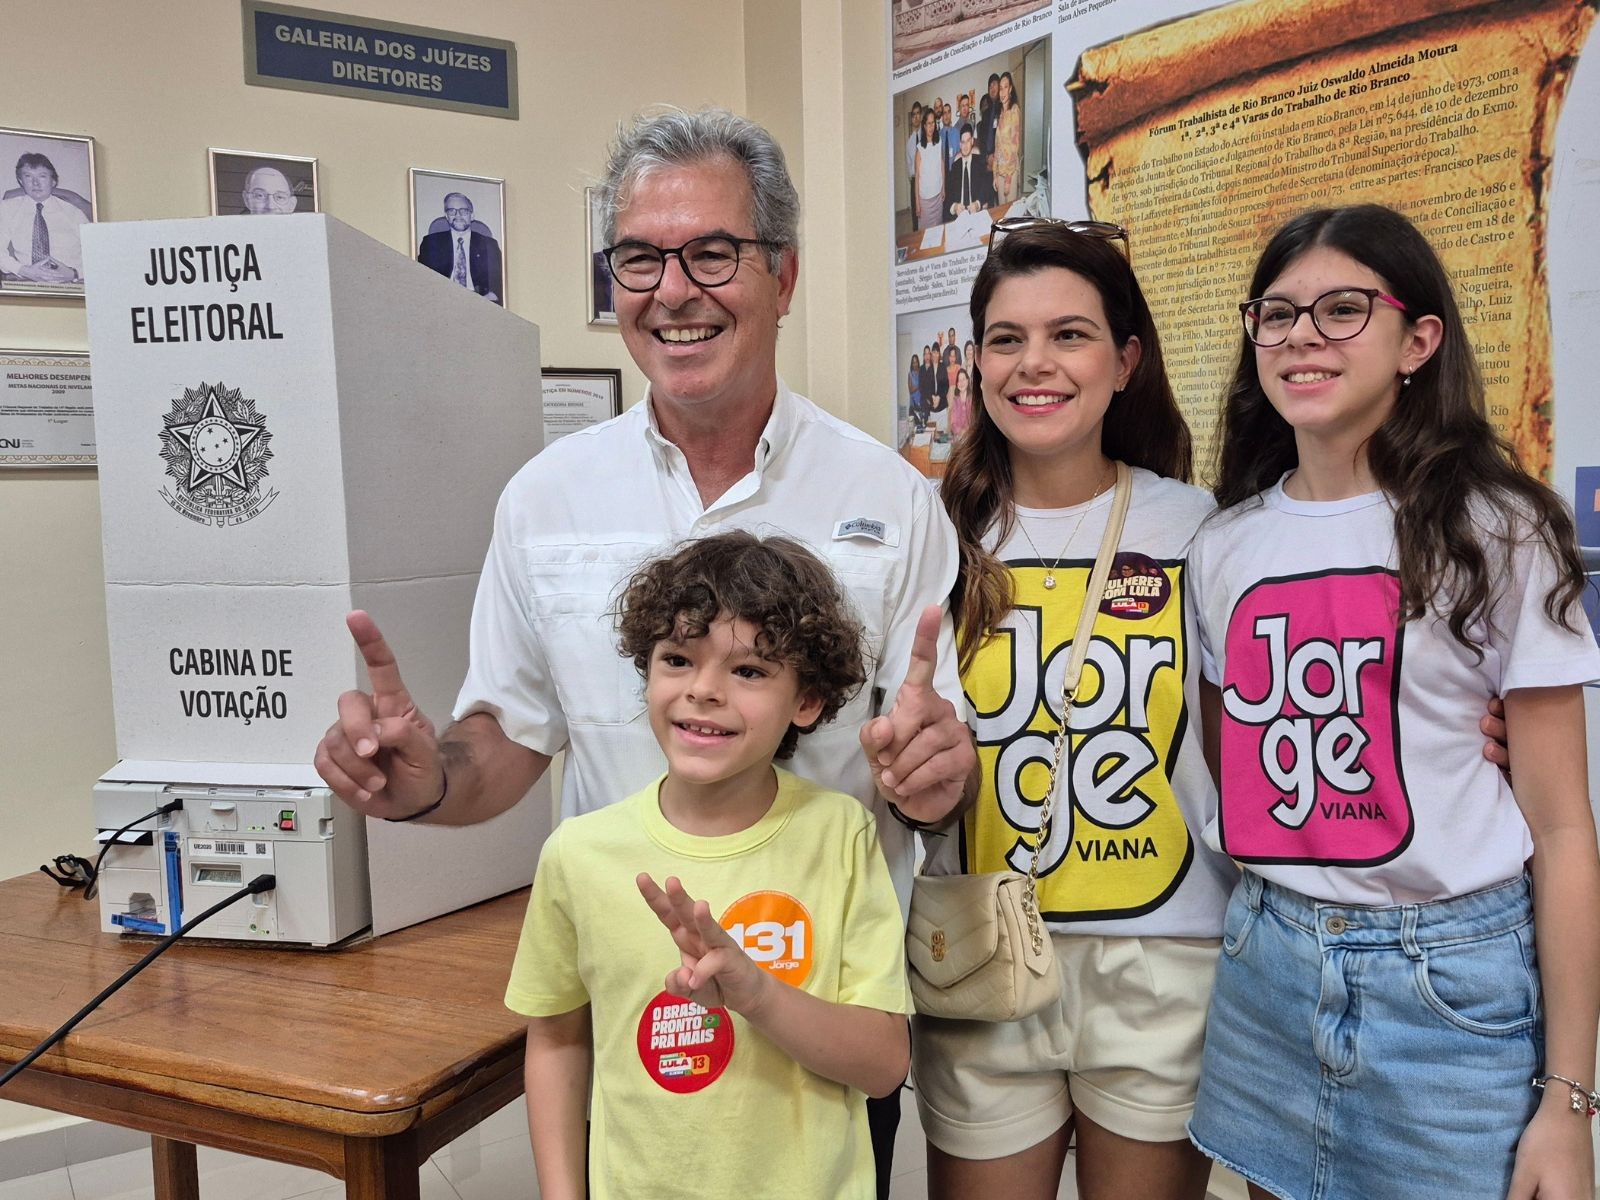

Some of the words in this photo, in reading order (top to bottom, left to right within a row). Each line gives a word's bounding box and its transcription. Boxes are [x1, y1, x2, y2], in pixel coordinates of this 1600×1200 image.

[1058, 2, 1069, 12] Sala
[1073, 8, 1087, 18] Alves
[275, 24, 368, 54] GALERIA
[375, 39, 417, 60] DOS
[423, 46, 492, 72] JUÍZES
[893, 68, 911, 80] Primeira
[912, 62, 922, 72] sede
[930, 55, 942, 65] Junta
[950, 40, 978, 58] Conciliação
[983, 27, 1013, 44] Julgamento
[1022, 19, 1032, 27] Rio
[1033, 11, 1052, 23] Branco
[332, 60, 443, 93] DIRETORES
[1149, 122, 1176, 138] Fórum
[1178, 110, 1227, 130] Trabalhista
[1229, 104, 1240, 115] de
[1242, 100, 1258, 111] Rio
[1260, 90, 1295, 106] Branco
[1297, 82, 1318, 96] Juiz
[1320, 69, 1366, 88] Oswaldo
[1368, 54, 1414, 75] Almeida
[1418, 43, 1458, 62] Moura
[1196, 127, 1208, 138] 2ª,
[1229, 116, 1240, 129] 4ª
[1242, 110, 1269, 125] Varas
[1271, 106, 1283, 117] do
[1285, 94, 1331, 113] Trabalho
[1334, 89, 1346, 100] de
[1349, 83, 1368, 96] Rio
[1370, 72, 1410, 90] Branco
[1232, 136, 1249, 147] Acre
[1250, 131, 1261, 143] foi
[1262, 122, 1300, 139] instalada
[1301, 120, 1314, 130] em
[1317, 116, 1332, 126] Rio
[1334, 107, 1368, 121] Branco,
[1370, 101, 1384, 112] em
[1386, 96, 1397, 108] 14
[1398, 93, 1411, 105] de
[1411, 84, 1441, 104] junho
[1442, 81, 1456, 94] de
[1458, 76, 1485, 90] 1973,
[1487, 70, 1510, 82] com
[1512, 66, 1519, 76] a
[1274, 141, 1284, 151] de
[1286, 137, 1300, 148] Rio
[1302, 129, 1336, 144] Branco,
[1338, 121, 1357, 137] pela
[1360, 118, 1374, 129] Lei
[1420, 104, 1432, 114] de
[1435, 101, 1447, 110] 10
[1450, 95, 1462, 108] de
[1464, 82, 1518, 105] dezembro
[1272, 154, 1282, 165] do
[1284, 144, 1323, 162] Trabalho
[1326, 142, 1336, 152] da
[1352, 131, 1388, 147] Região,
[1390, 127, 1402, 137] na
[1404, 112, 1462, 137] presidência
[1466, 107, 1480, 119] do
[1482, 101, 1518, 115] Exmo.
[1281, 163, 1318, 179] Ministro
[1319, 158, 1330, 169] do
[1330, 149, 1370, 166] Tribunal
[1372, 141, 1415, 157] Superior
[1415, 135, 1428, 146] do
[1428, 124, 1479, 143] Trabalho.
[1345, 154, 1412, 178] (denominação
[1420, 143, 1458, 162] época).
[1310, 185, 1345, 200] 001/73,
[1350, 178, 1376, 191] entre
[1376, 178, 1386, 186] as
[1388, 169, 1421, 186] partes:
[1424, 157, 1474, 175] Francisco
[1476, 150, 1500, 163] Paes
[1503, 147, 1517, 158] de
[1410, 192, 1462, 209] novembro
[1464, 187, 1478, 199] de
[1480, 181, 1506, 196] 1986
[1510, 182, 1516, 191] e
[1431, 209, 1443, 220] de
[1445, 198, 1507, 218] Conciliação
[1509, 198, 1516, 207] e
[1424, 223, 1463, 237] ocorreu
[1466, 220, 1482, 230] em
[1486, 215, 1499, 227] 18
[1501, 212, 1515, 223] de
[1456, 236, 1469, 247] de
[1470, 232, 1506, 245] Castro
[1508, 231, 1515, 239] e
[144, 244, 262, 292] JUSTIÇA
[1452, 263, 1514, 280] atualmente
[1460, 279, 1513, 294] Nogueira,
[1489, 295, 1513, 306] Luiz
[131, 302, 283, 344] ELEITORAL
[1480, 311, 1512, 322] Viana
[1498, 341, 1511, 352] de
[1480, 360, 1510, 370] atuou
[1490, 405, 1509, 416] Rio
[242, 497, 258, 509] BRASIL
[1102, 588, 1126, 600] OM
[1130, 586, 1160, 596] LULA
[1105, 576, 1162, 590] ULHERES
[170, 648, 256, 676] CABINA
[262, 650, 293, 676] DE
[180, 686, 287, 725] VOTAÇÃO
[1320, 802, 1388, 820] VIANA
[1075, 837, 1159, 862] VIANA
[726, 920, 805, 962] 131
[769, 961, 799, 970] Jorge
[652, 1015, 703, 1035] PRONTO
[653, 1007, 661, 1021] O
[651, 1035, 676, 1050] PRA
[678, 1028, 714, 1047] MAIS
[660, 1059, 689, 1069] LULA
[692, 1056, 705, 1070] 13
